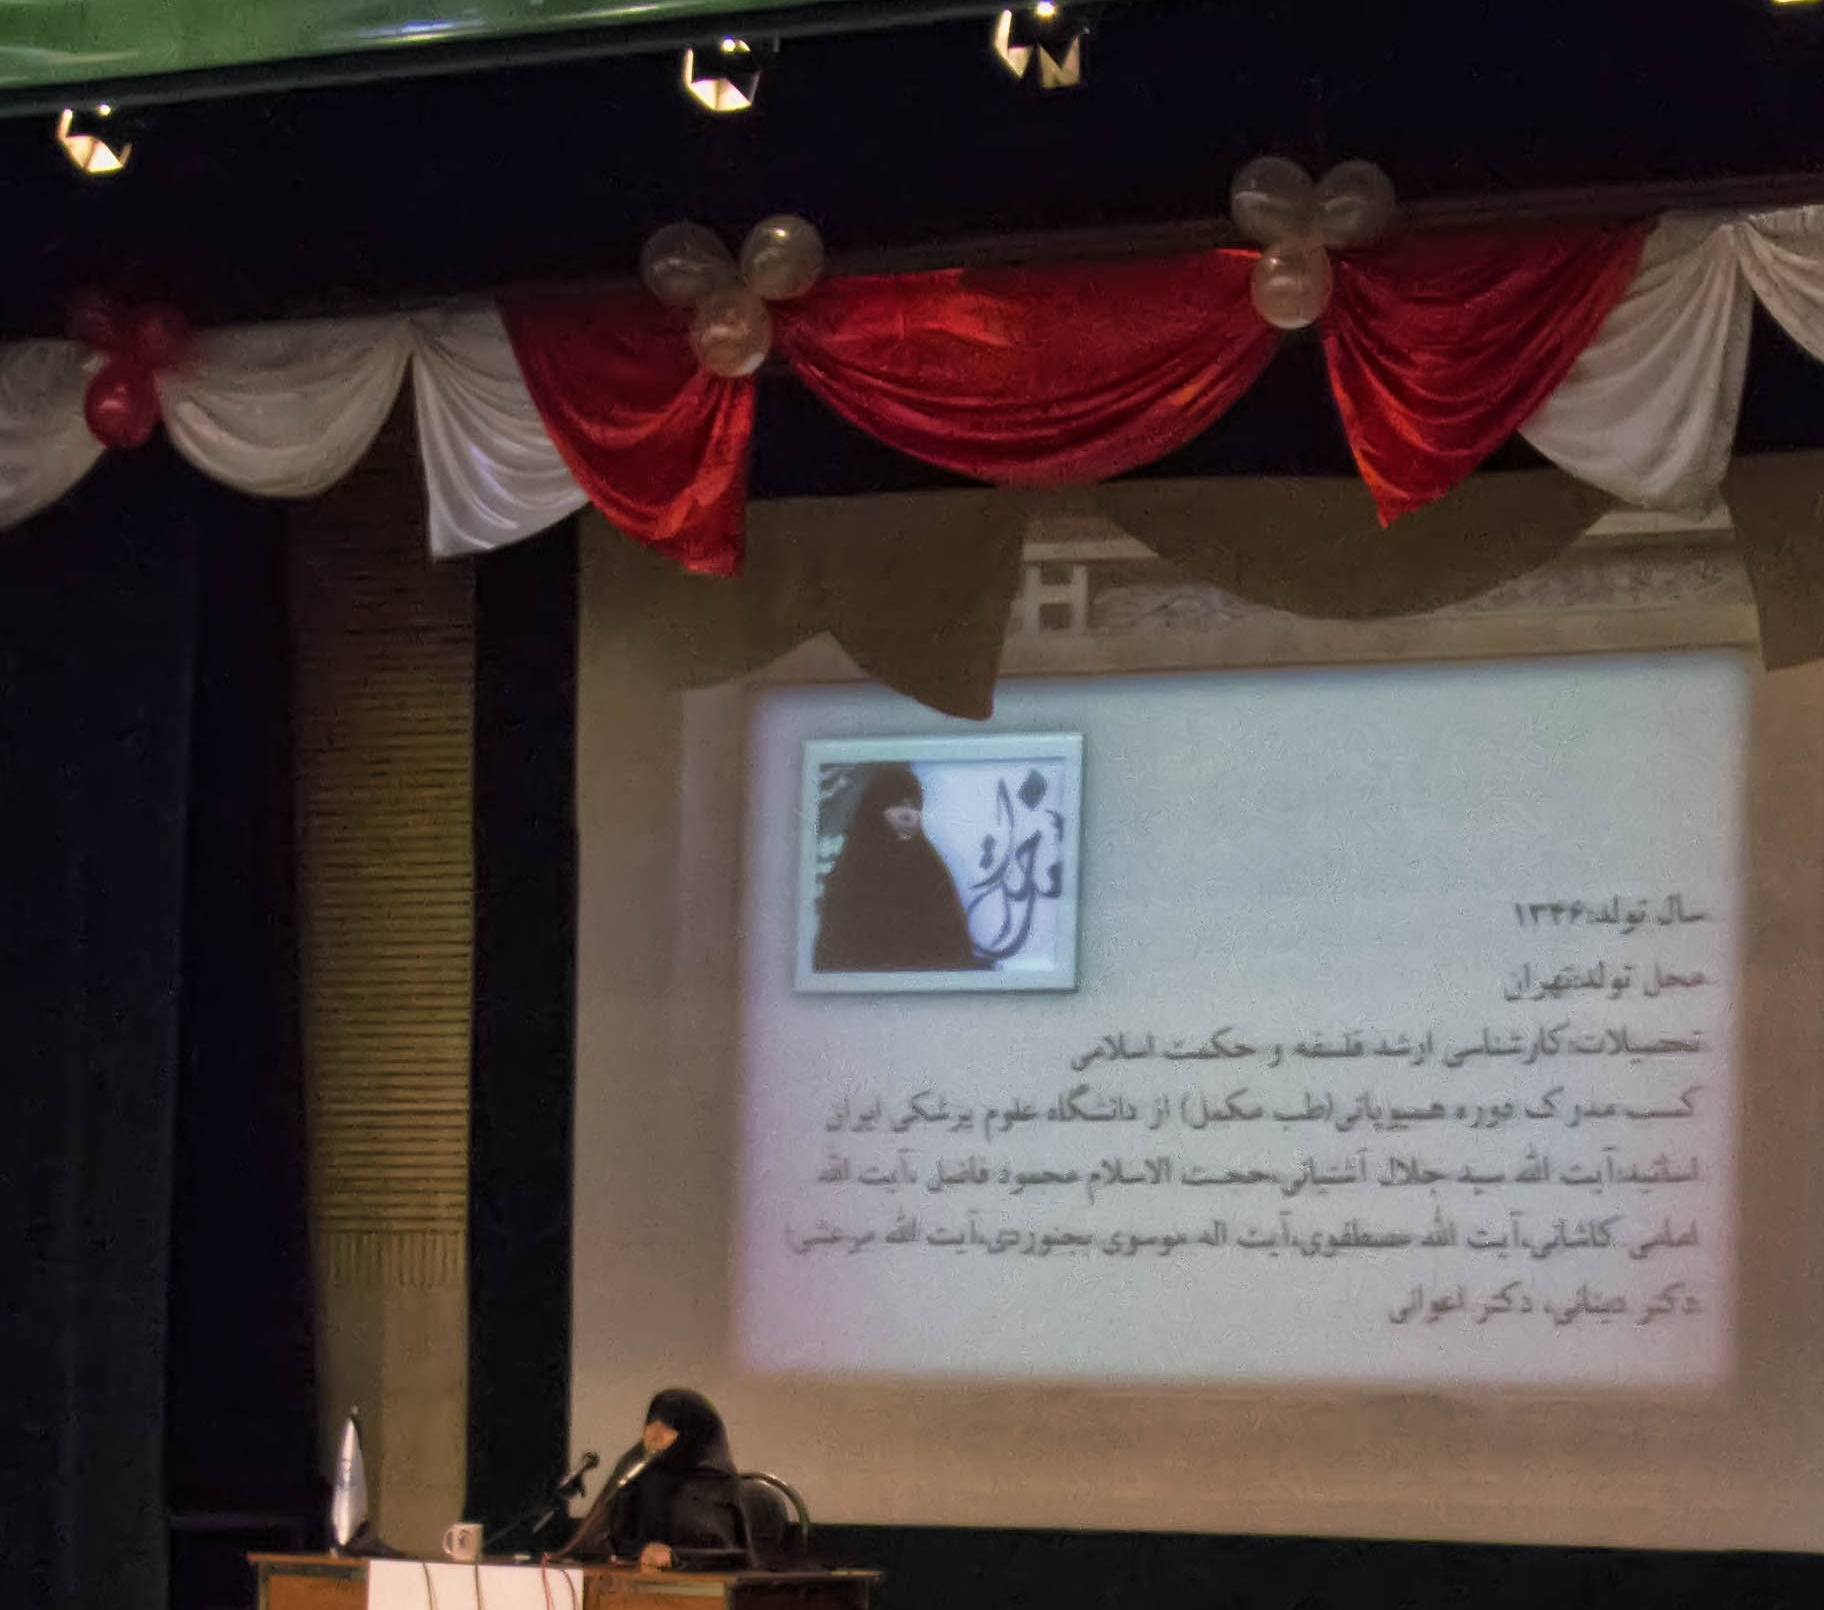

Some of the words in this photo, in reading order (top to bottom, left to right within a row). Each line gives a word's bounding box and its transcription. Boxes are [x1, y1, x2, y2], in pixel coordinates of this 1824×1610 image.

[1653, 893, 1706, 925] سال
[1643, 963, 1706, 998] محل
[1071, 1034, 1157, 1072] اسلامی
[1161, 1027, 1256, 1060] حکمت
[1267, 1044, 1283, 1067] و
[1373, 1030, 1431, 1065] ارشد
[825, 1094, 880, 1132] ایران
[980, 1097, 1038, 1142] علوم
[1047, 1084, 1134, 1120] دانشگاه
[1144, 1094, 1169, 1129] از
[1456, 1103, 1514, 1128] دوره
[1523, 1086, 1617, 1128] مدرک
[1623, 1086, 1700, 1124] کسب
[998, 1165, 1078, 1195] محمود
[1380, 1157, 1446, 1195] جلال
[1457, 1165, 1505, 1195] سید
[1514, 1143, 1550, 1183] الله
[885, 1207, 918, 1243] الله
[1421, 1206, 1458, 1247] الله
[1476, 1281, 1532, 1324] دکتر
[1634, 1282, 1704, 1326] دکتر
